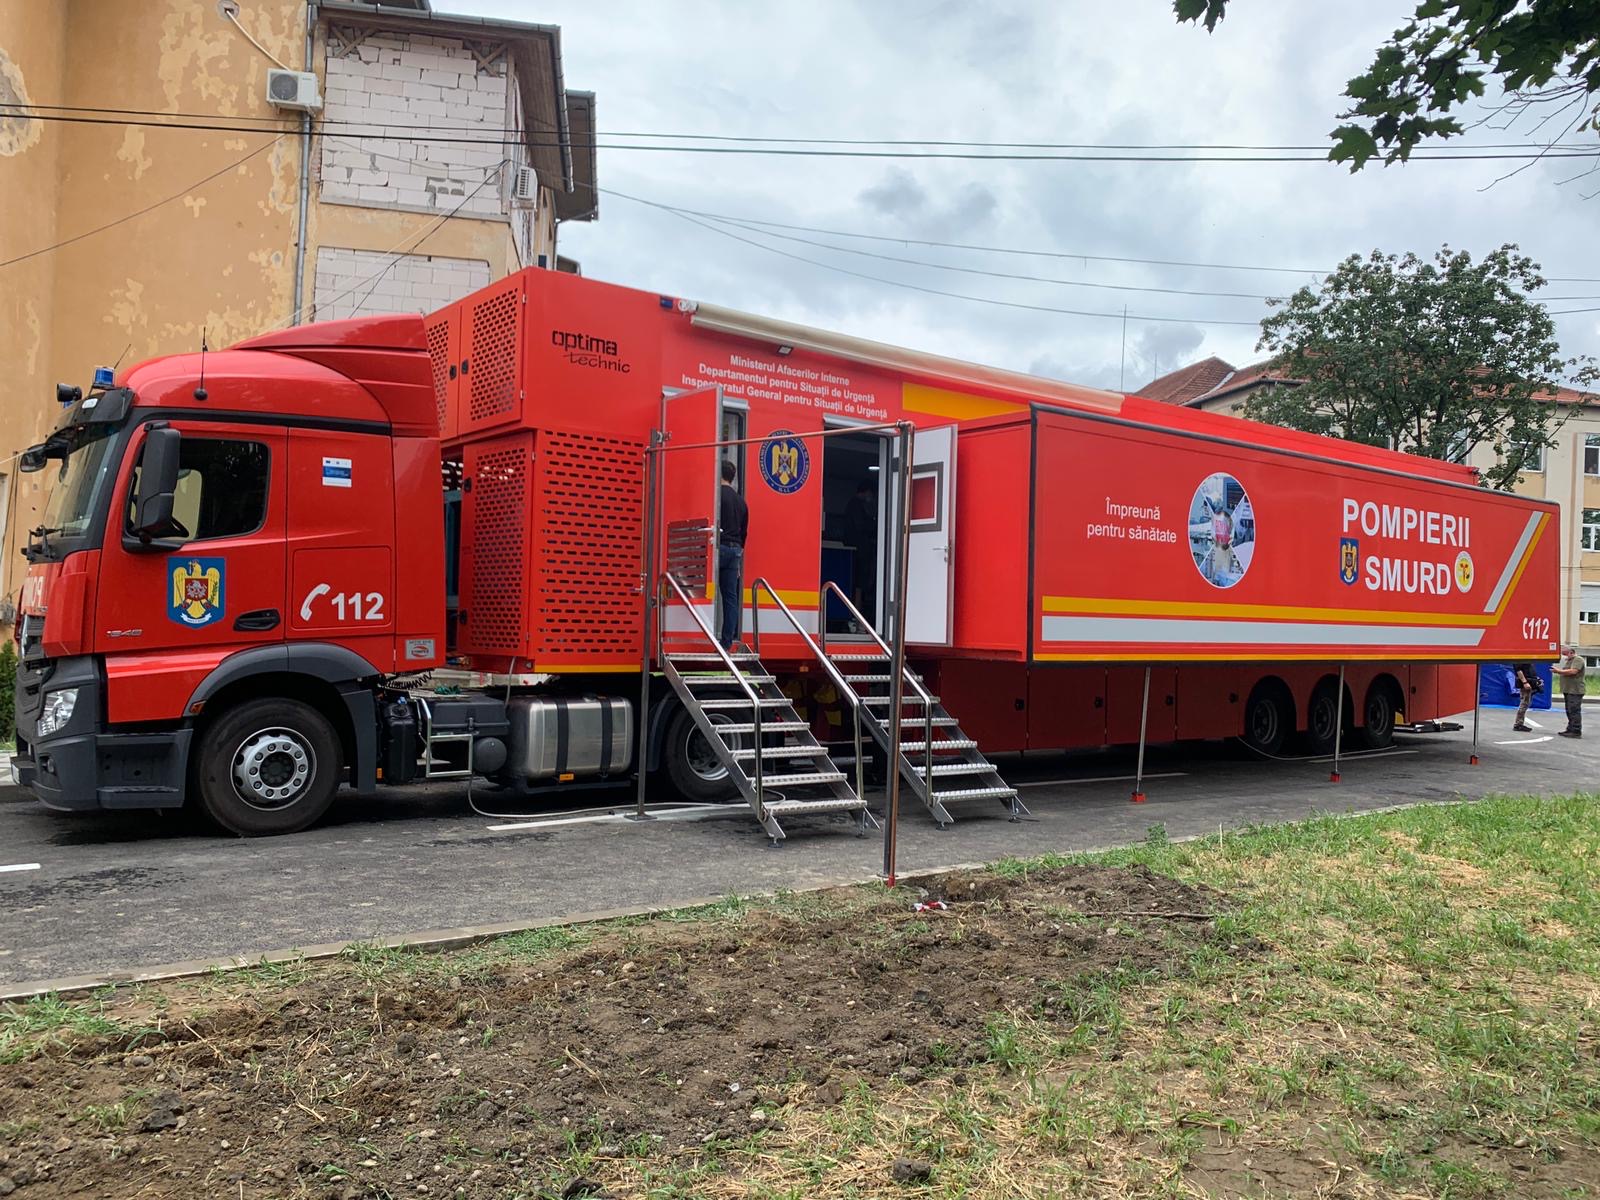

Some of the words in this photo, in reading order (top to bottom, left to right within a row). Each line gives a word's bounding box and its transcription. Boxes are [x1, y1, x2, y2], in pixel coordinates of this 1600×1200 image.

[552, 330, 617, 356] optima
[563, 352, 631, 373] technic
[730, 355, 775, 373] Ministerul
[777, 364, 819, 380] Afacerilor
[821, 372, 849, 386] Interne
[682, 374, 744, 394] Insperatul
[747, 386, 782, 401] General
[784, 394, 812, 406] pentru
[845, 403, 854, 413] de
[699, 363, 767, 385] Departamentul
[769, 378, 798, 390] pentru
[832, 389, 841, 398] de
[1106, 497, 1161, 521] Împreună
[1343, 498, 1470, 548] POMPIERII
[1087, 522, 1125, 539] pentru
[1128, 525, 1177, 543] sănătate
[1365, 555, 1451, 595] SMURD
[331, 592, 384, 620] 112
[1528, 617, 1550, 640] 112
